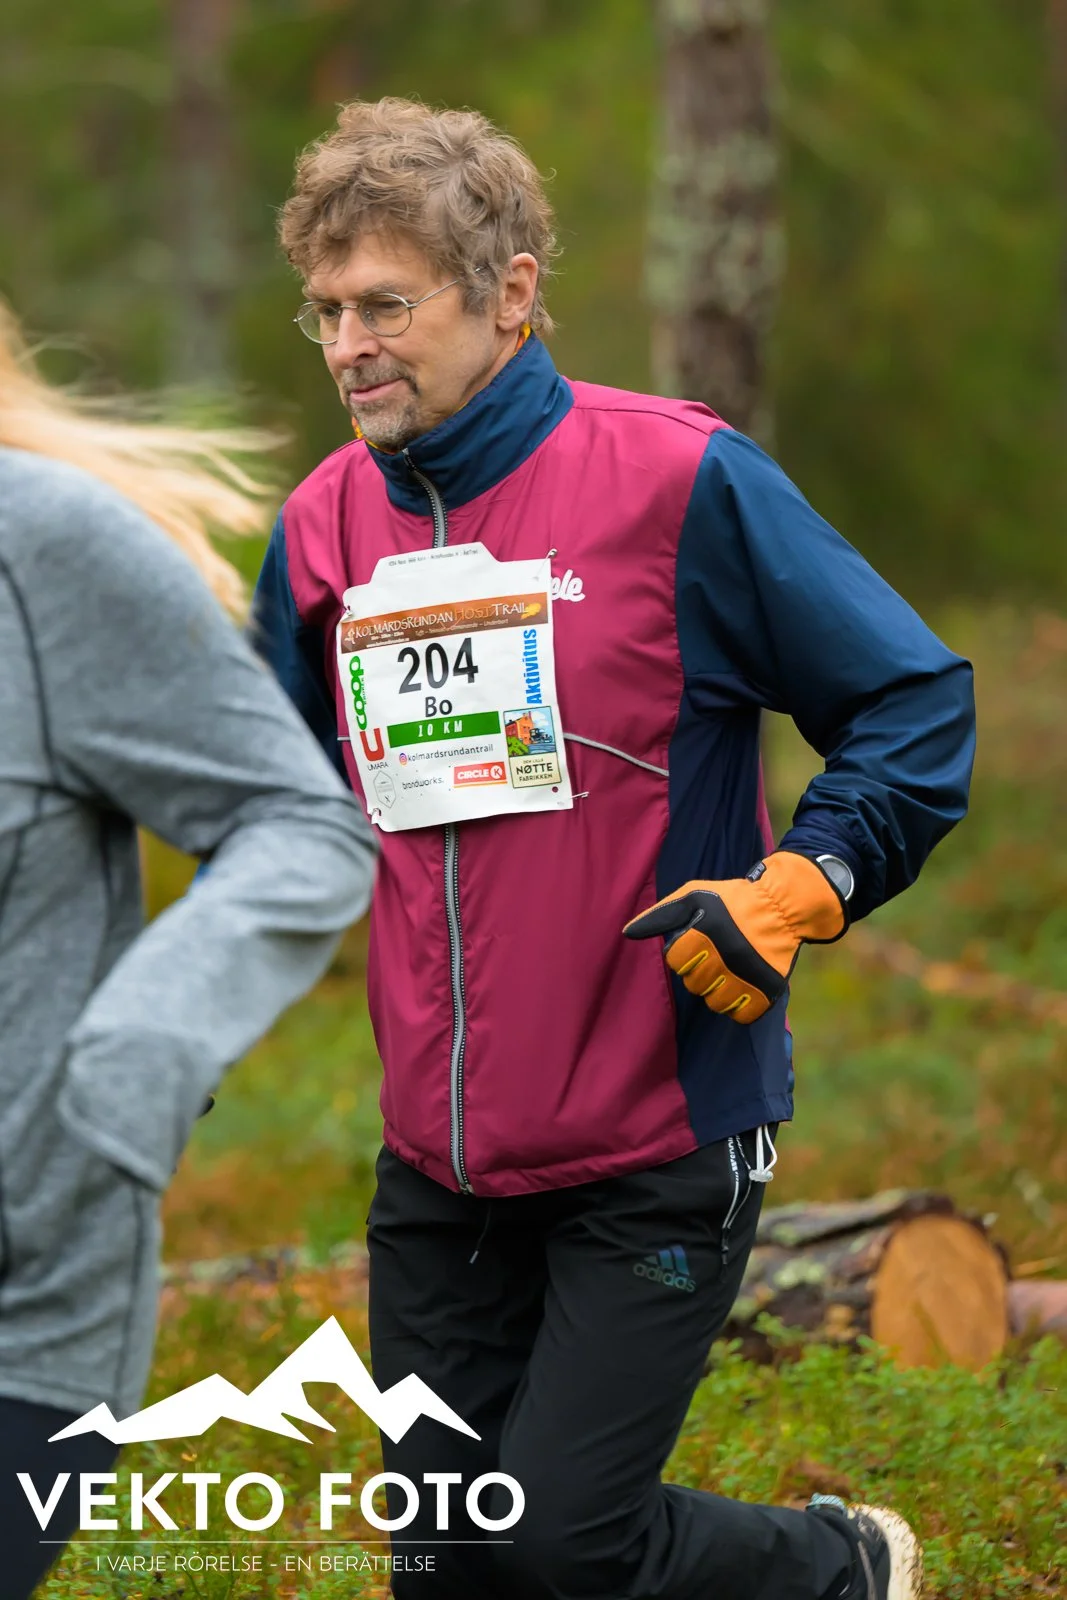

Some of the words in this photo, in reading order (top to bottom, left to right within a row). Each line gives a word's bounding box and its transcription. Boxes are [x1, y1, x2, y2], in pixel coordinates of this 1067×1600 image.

[550, 569, 586, 602] ele
[397, 637, 479, 694] 204
[522, 628, 542, 704] Aktivitus
[349, 655, 368, 730] coop
[425, 696, 453, 718] Bo
[418, 723, 434, 738] 10
[443, 720, 463, 734] KM
[367, 761, 389, 771] UMARA
[457, 768, 490, 780] CIRCLE
[516, 762, 554, 775] NØTTE
[633, 1262, 696, 1293] adidas
